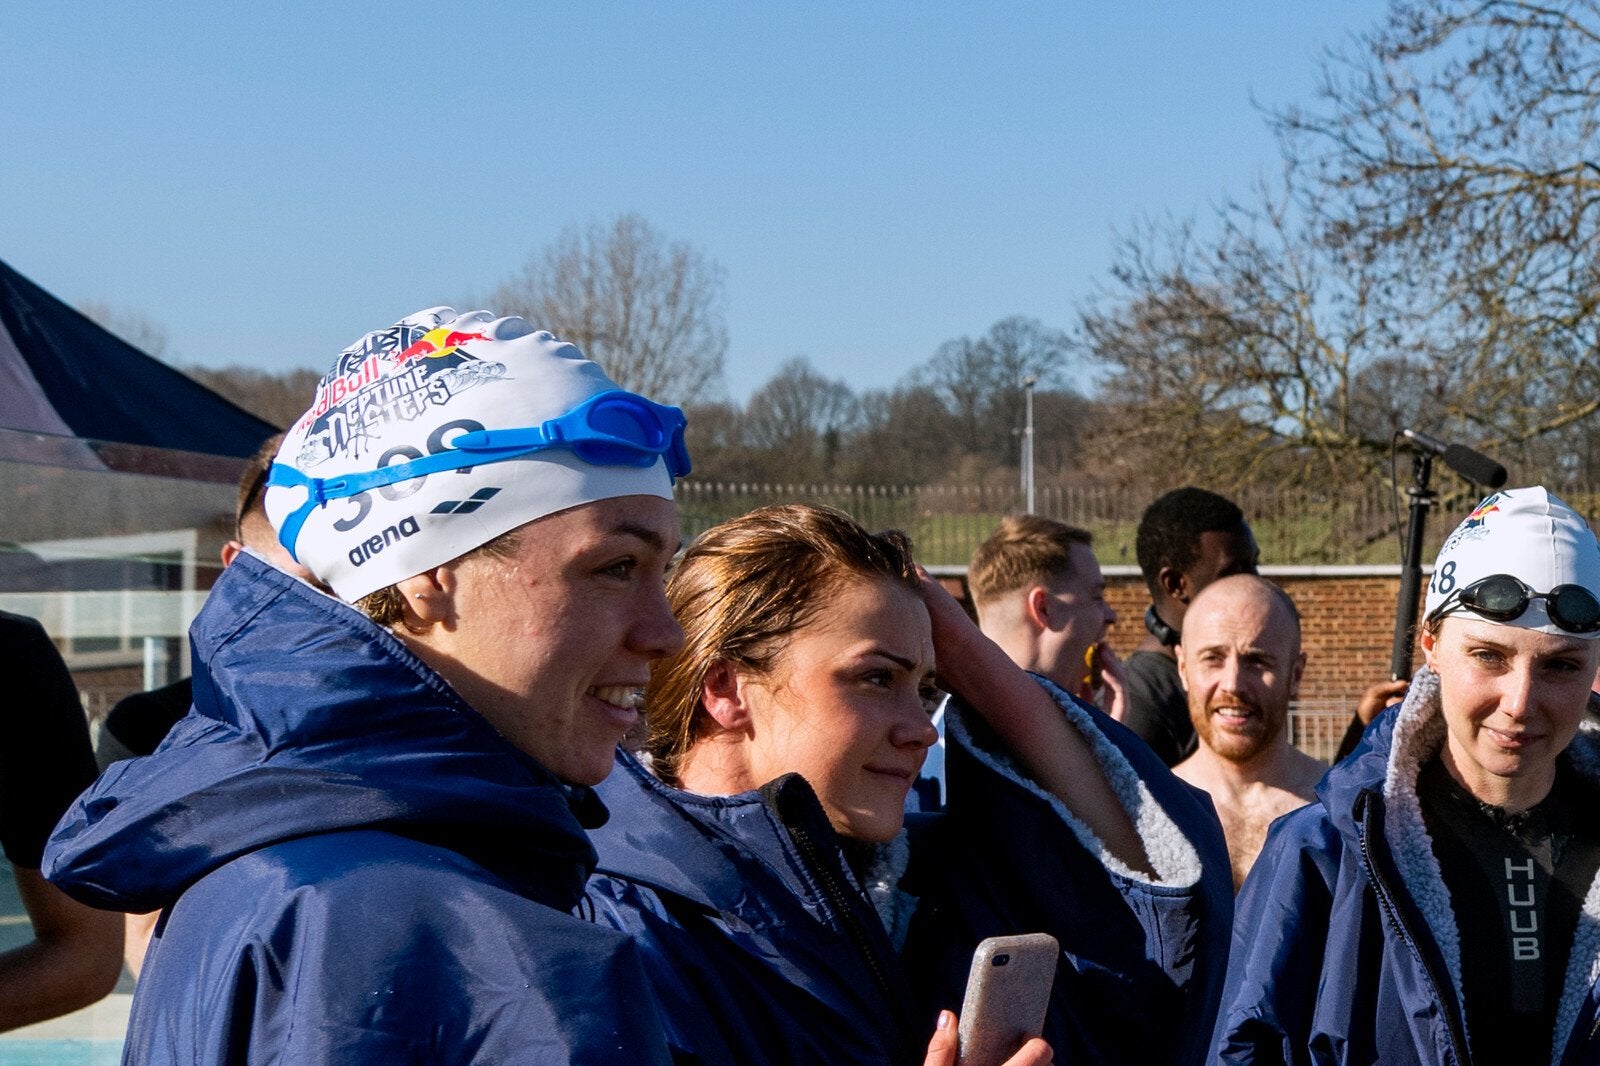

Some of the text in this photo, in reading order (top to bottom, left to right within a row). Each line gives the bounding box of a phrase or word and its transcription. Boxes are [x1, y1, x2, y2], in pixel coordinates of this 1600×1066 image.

[332, 356, 379, 406] Bull
[348, 515, 421, 567] arena
[1504, 857, 1541, 961] HUUB
